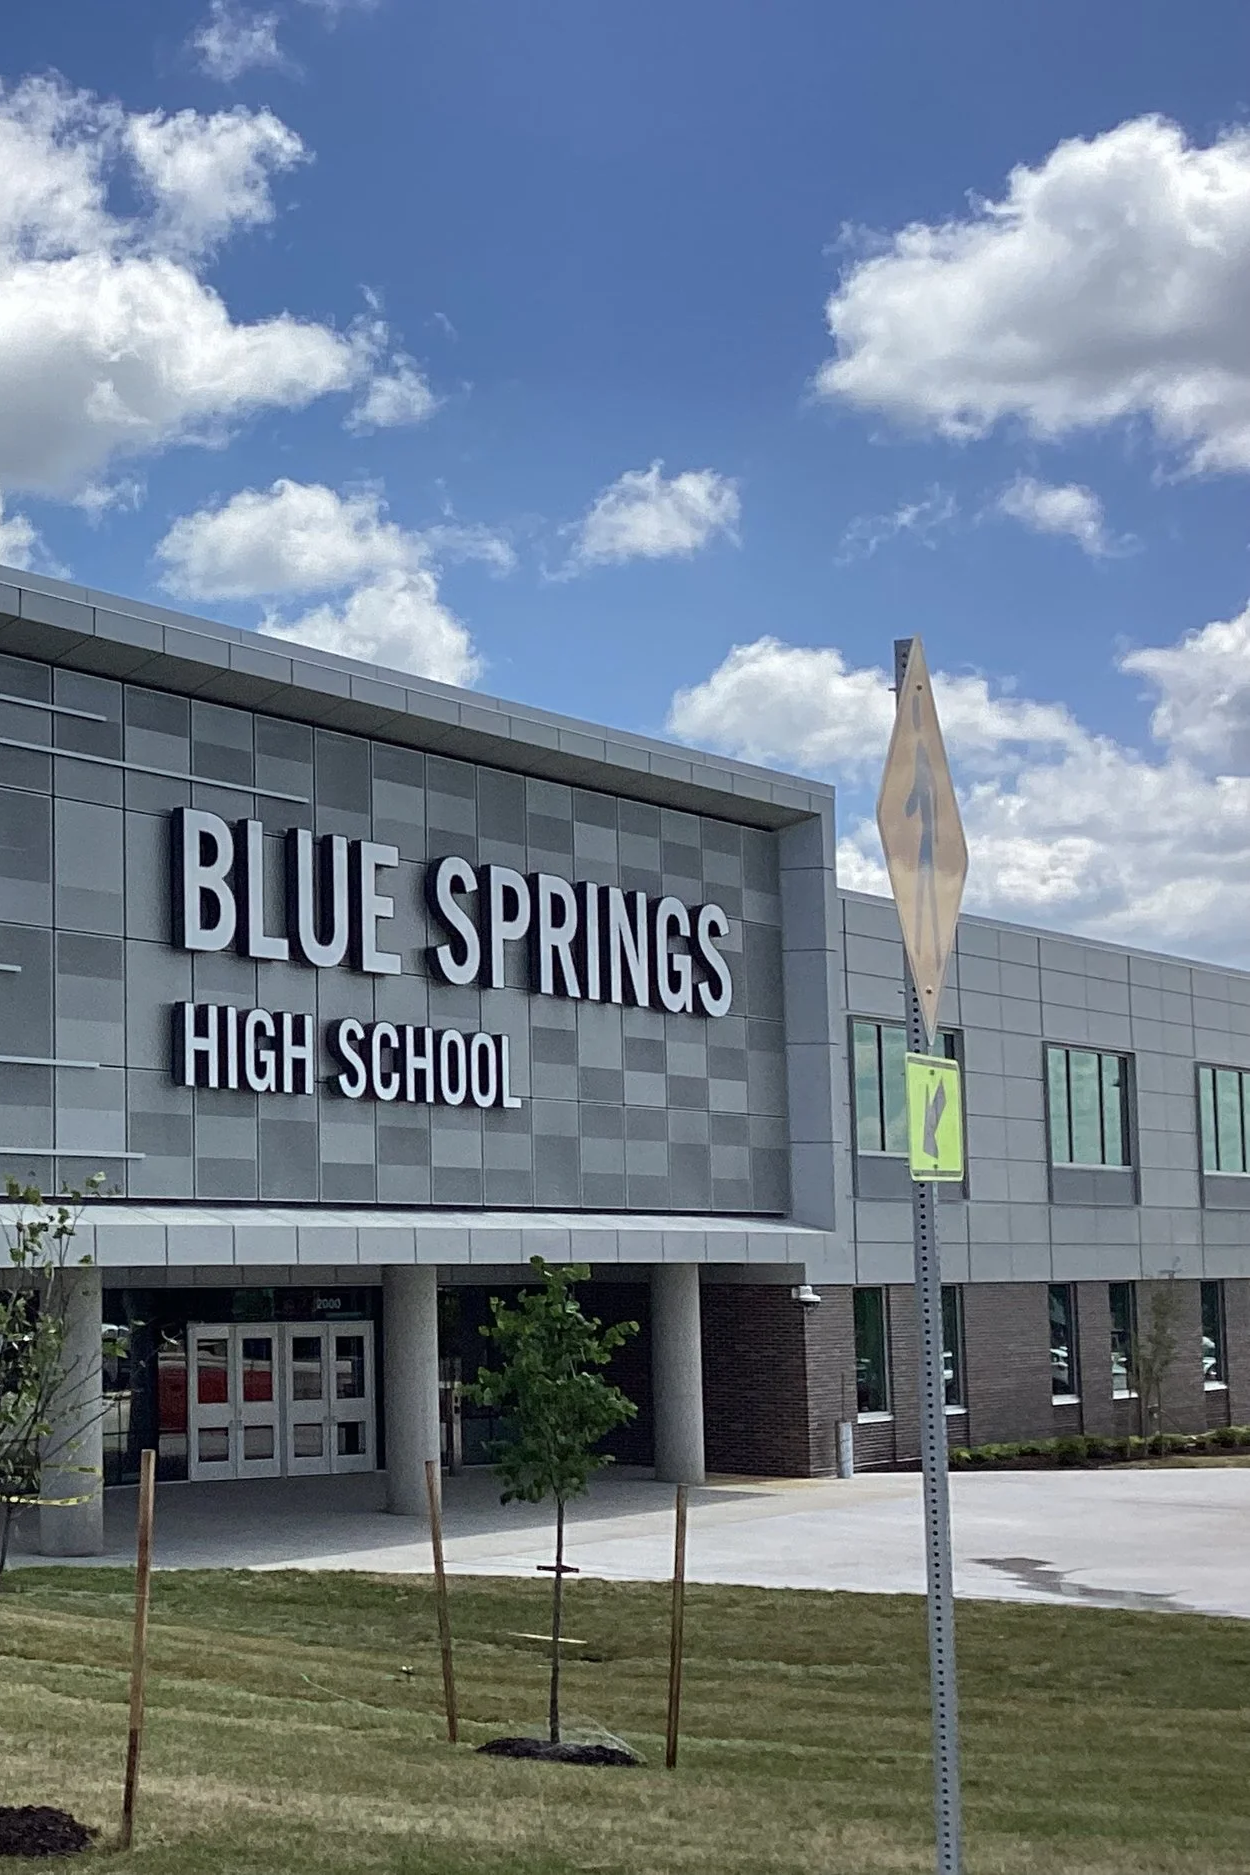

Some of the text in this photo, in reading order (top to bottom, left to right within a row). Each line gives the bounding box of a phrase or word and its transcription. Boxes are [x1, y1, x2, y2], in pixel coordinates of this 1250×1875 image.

[174, 807, 733, 1018] BLUE SPRINGS
[176, 1001, 522, 1109] HIGH SCHOOL
[316, 1298, 341, 1309] 2000
